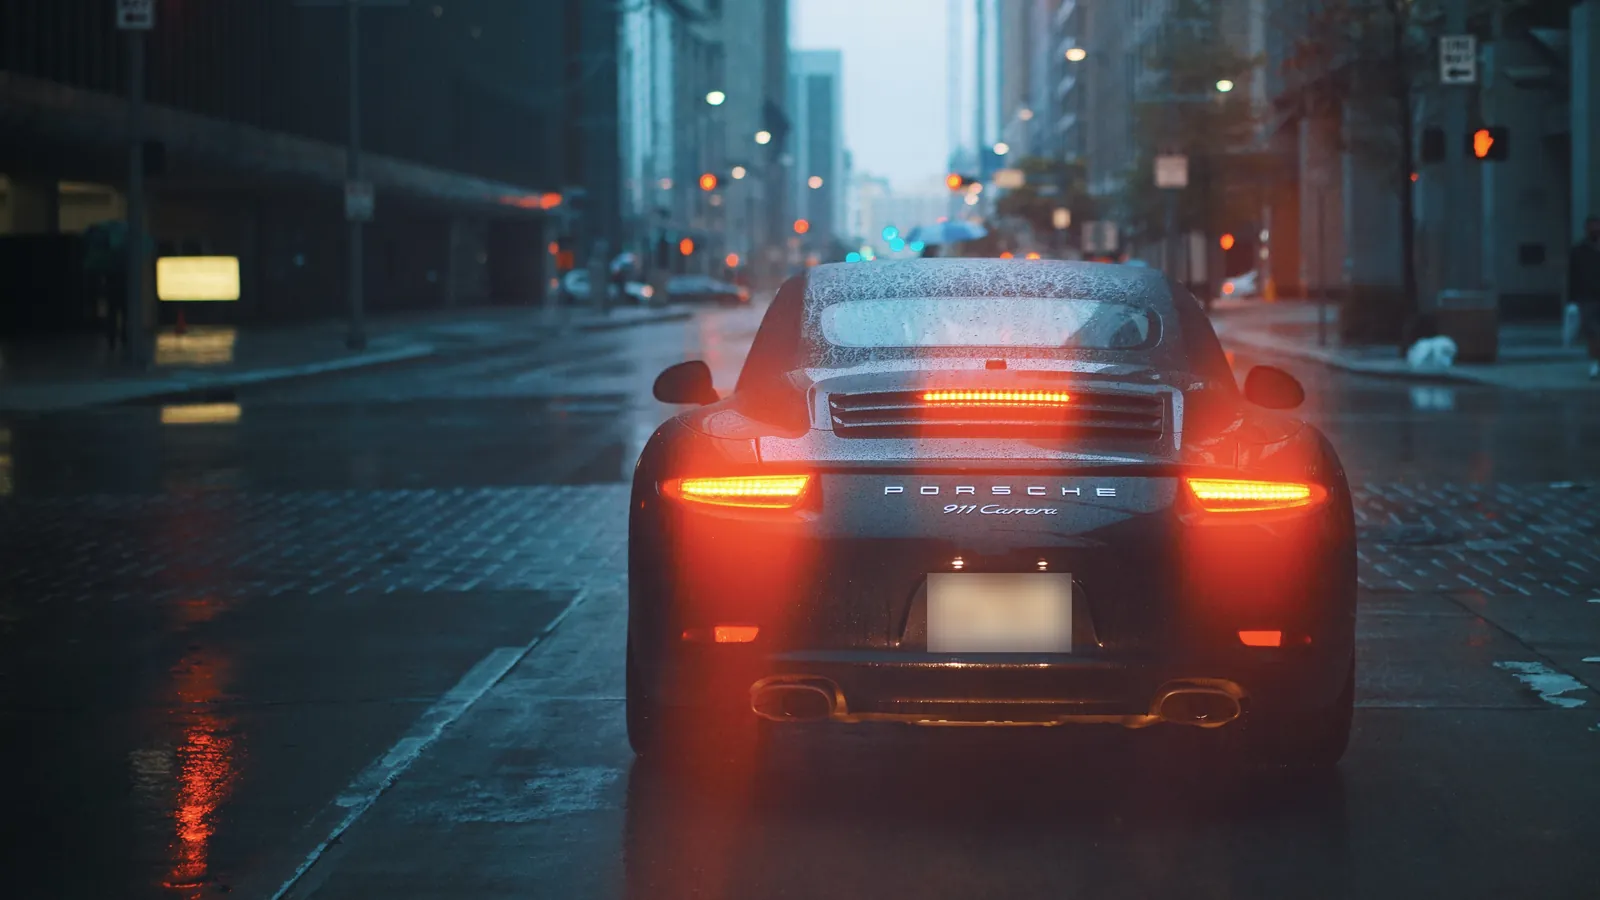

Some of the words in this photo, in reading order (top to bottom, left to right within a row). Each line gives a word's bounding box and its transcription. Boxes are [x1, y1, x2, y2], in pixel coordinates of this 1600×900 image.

[884, 486, 1117, 497] PORSCHE
[943, 504, 976, 514] 911
[980, 504, 1058, 515] Carrera
